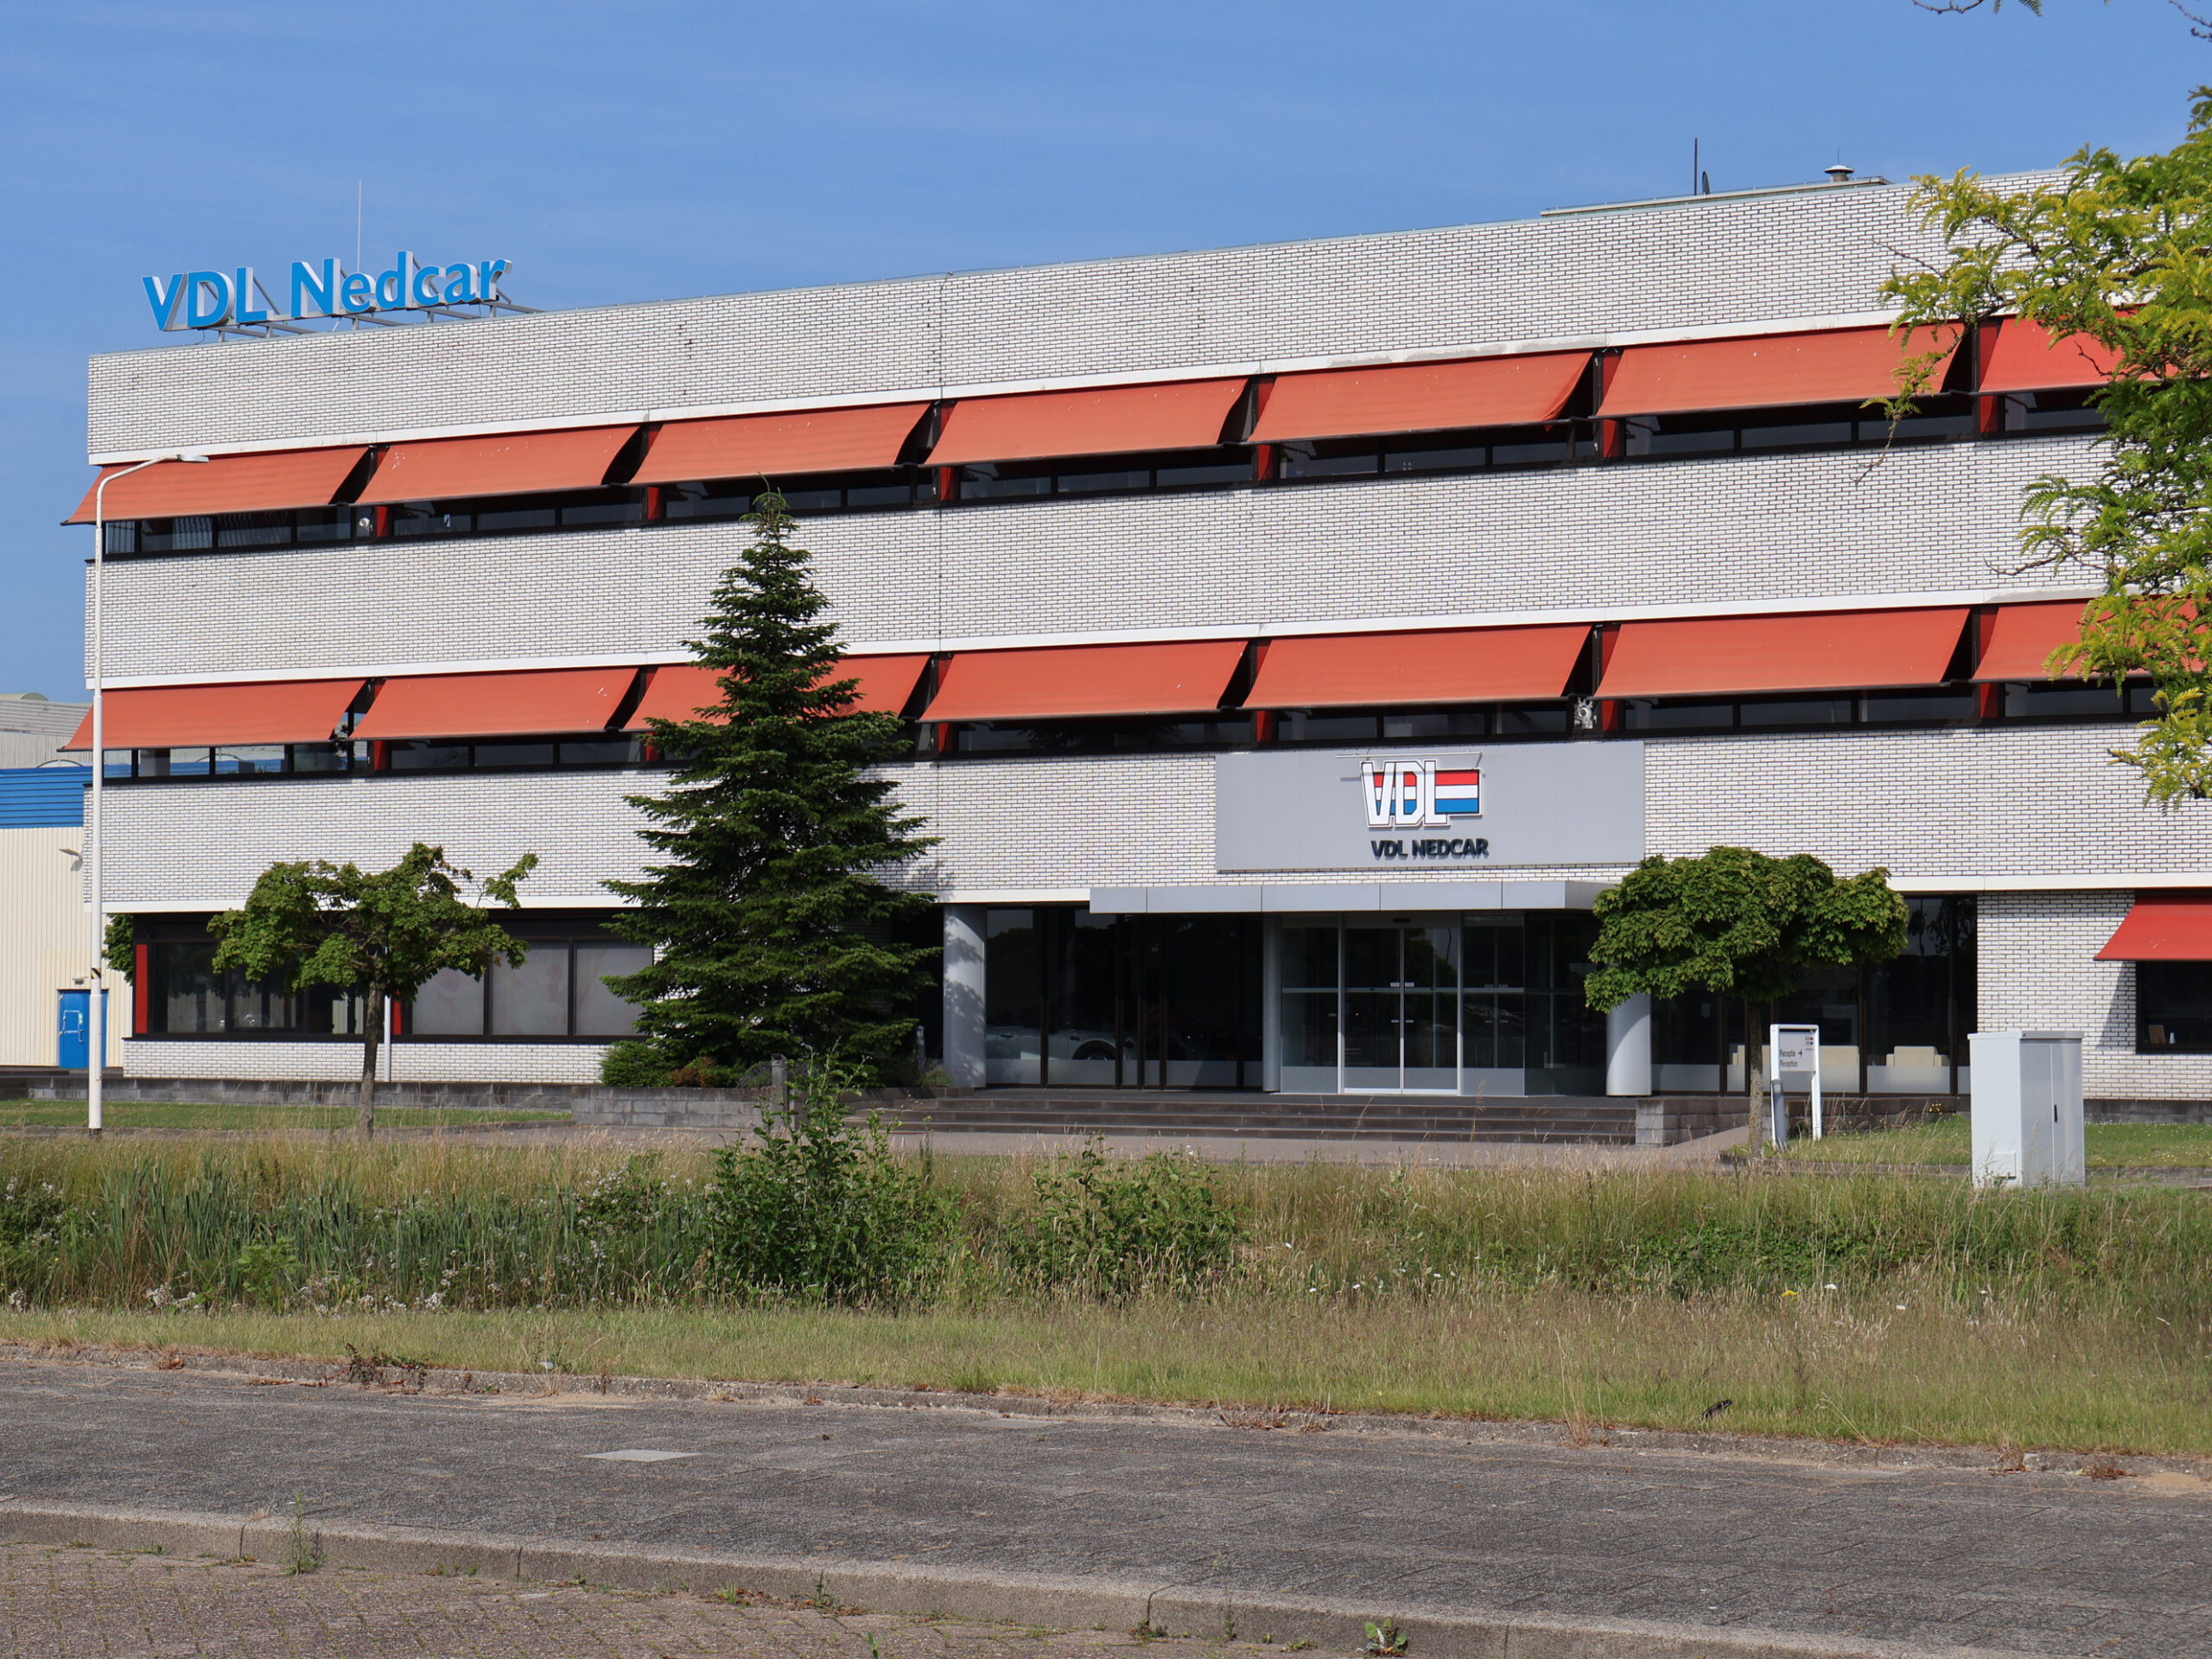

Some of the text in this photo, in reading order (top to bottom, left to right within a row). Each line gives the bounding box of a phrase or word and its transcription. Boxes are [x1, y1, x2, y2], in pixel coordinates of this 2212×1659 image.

[141, 251, 512, 331] VDL Nedcar
[1361, 760, 1451, 826] VDL
[1370, 838, 1489, 857] VDL NEDCAR
